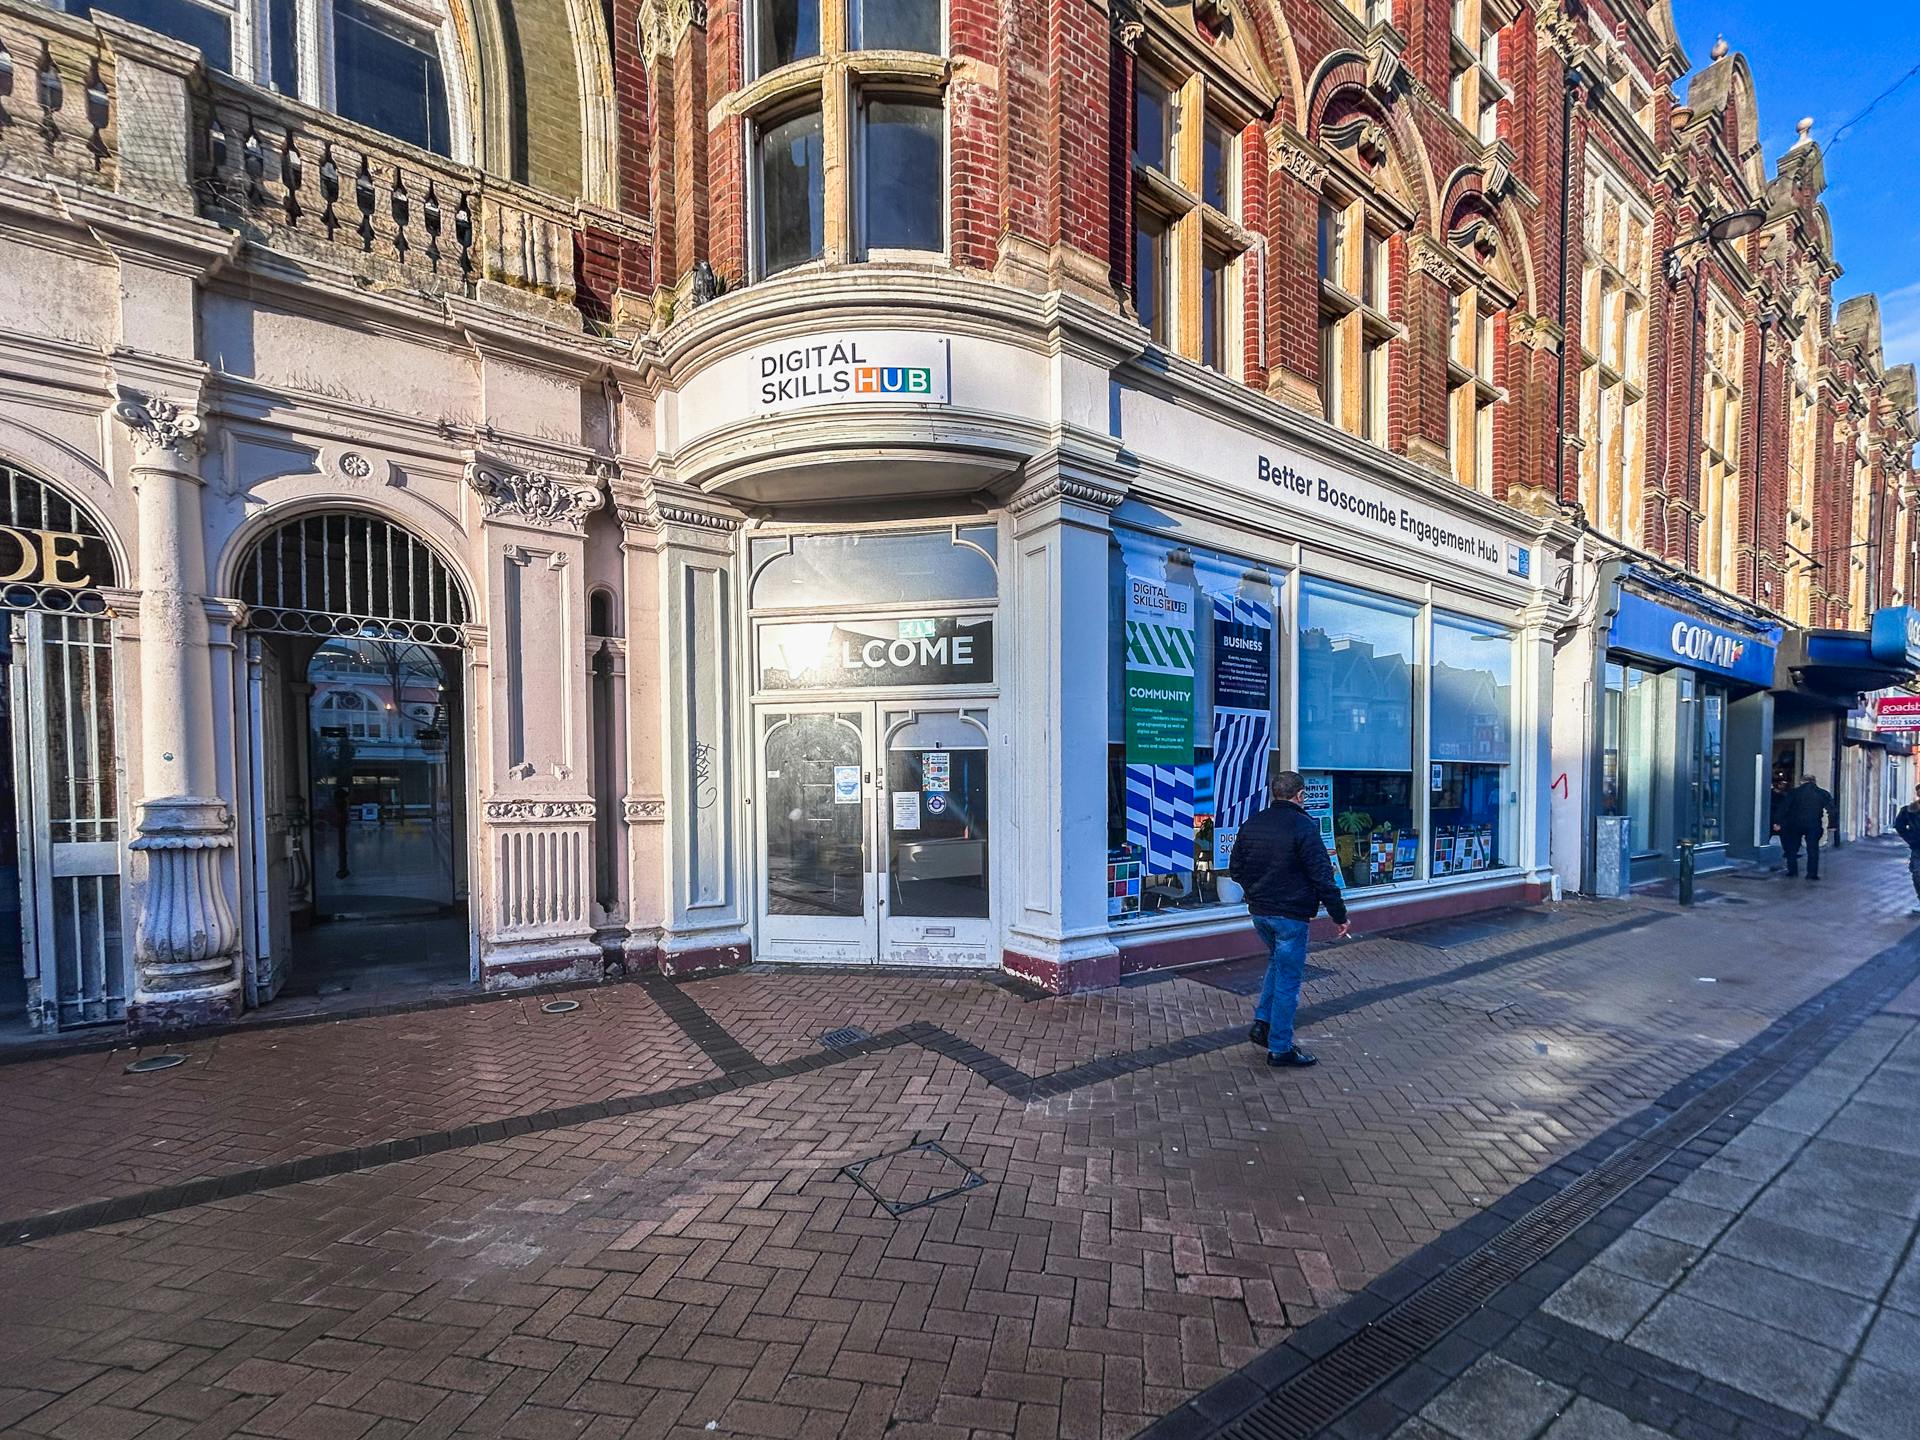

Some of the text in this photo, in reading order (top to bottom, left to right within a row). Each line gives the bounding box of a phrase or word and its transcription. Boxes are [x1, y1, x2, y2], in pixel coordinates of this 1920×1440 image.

[761, 342, 867, 378] DIGITAL
[761, 368, 928, 404] SKILLS HUB
[1258, 455, 1312, 496] Better
[1318, 478, 1396, 526] Boscombe
[1400, 509, 1475, 555] Engagement
[1478, 539, 1498, 563] Hub
[1133, 583, 1169, 598] DIGITAL
[779, 635, 975, 669] LCOME
[1223, 635, 1263, 652] BUSINESS
[1672, 621, 1736, 669] CORAL
[1129, 687, 1191, 702] COMMUNITY
